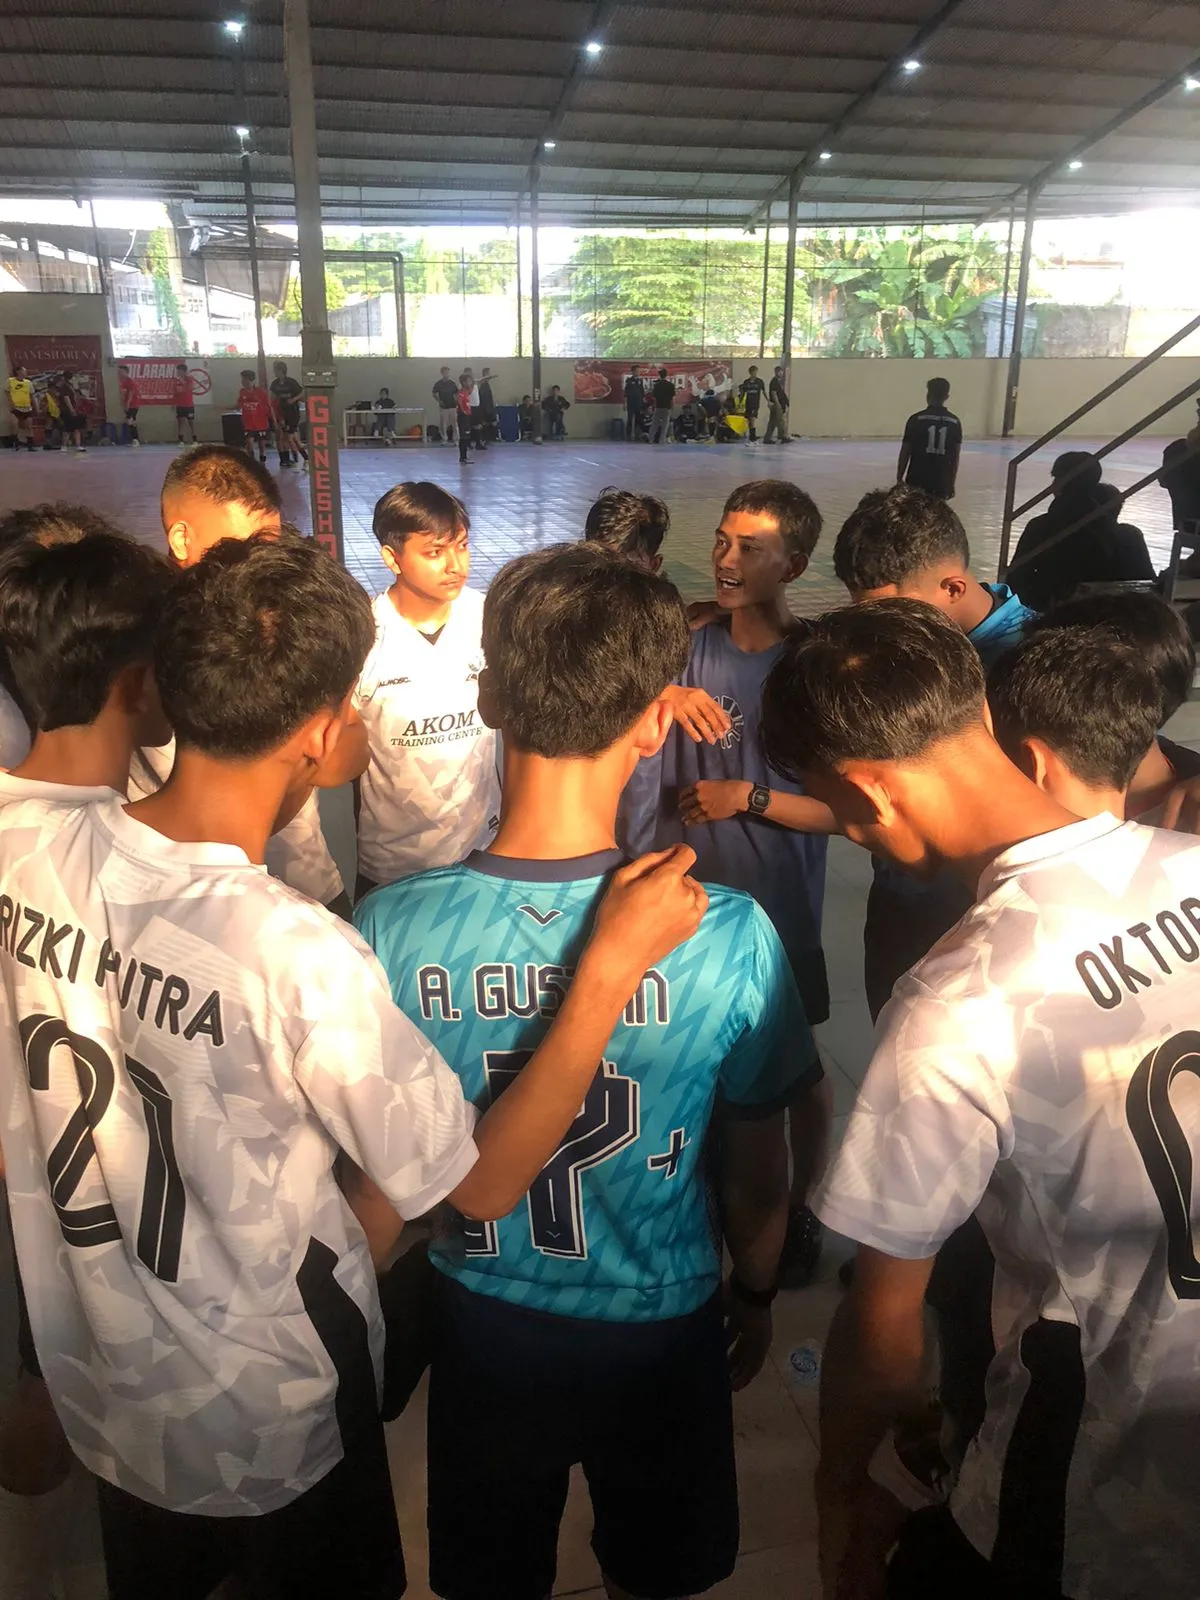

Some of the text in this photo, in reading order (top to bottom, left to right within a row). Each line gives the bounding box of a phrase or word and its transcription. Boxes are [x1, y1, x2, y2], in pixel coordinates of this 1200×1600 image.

[926, 425, 947, 455] 11
[402, 709, 476, 737] AKOM
[390, 735, 445, 747] TRAINING
